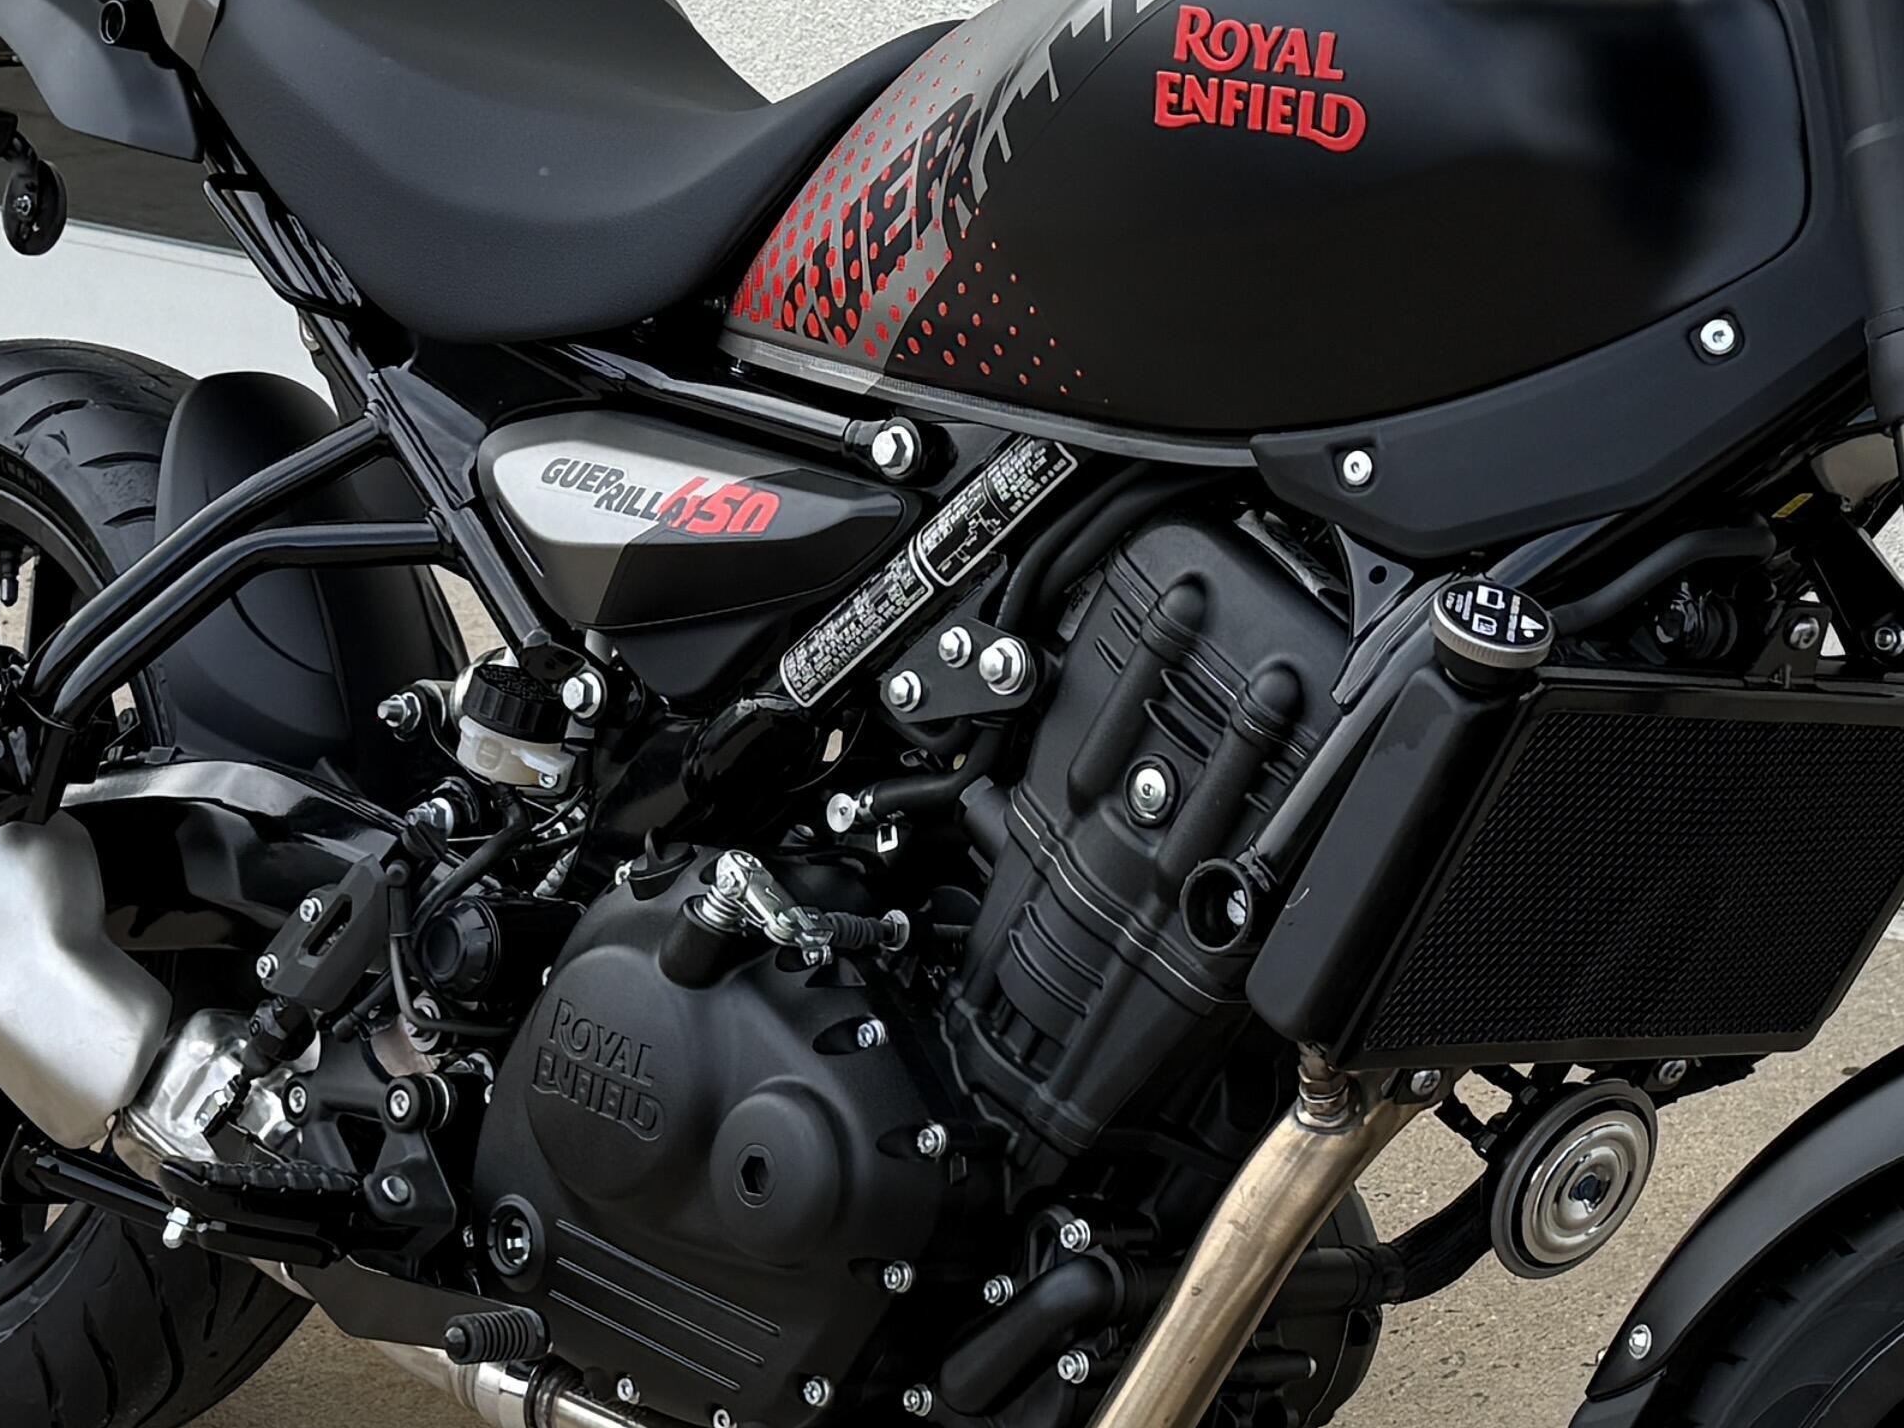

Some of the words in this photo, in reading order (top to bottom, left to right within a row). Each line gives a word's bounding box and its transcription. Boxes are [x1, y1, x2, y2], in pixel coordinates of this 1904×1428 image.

[1173, 4, 1345, 82] ROYAL
[1154, 70, 1368, 153] ENFIELD
[659, 476, 781, 535] 450
[547, 997, 656, 1088] ROYAL
[530, 1046, 666, 1142] ENFIELD
